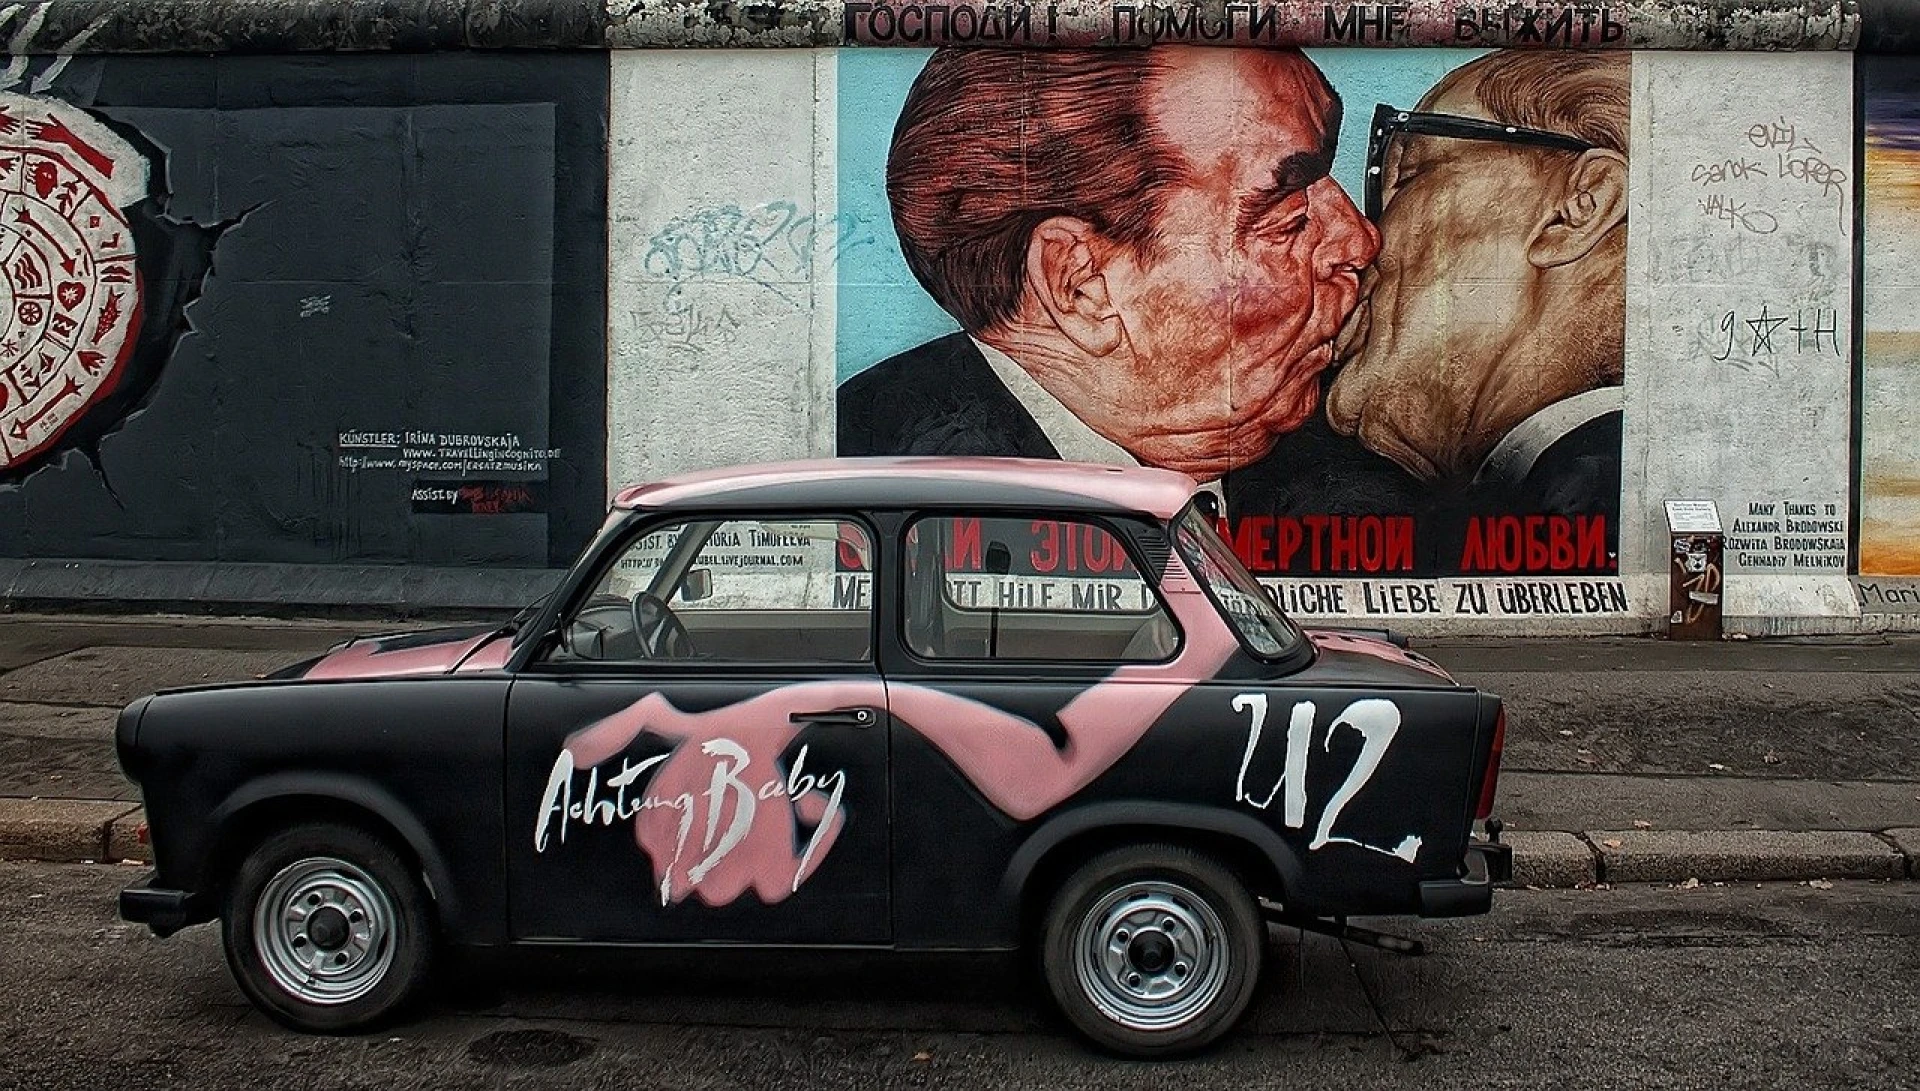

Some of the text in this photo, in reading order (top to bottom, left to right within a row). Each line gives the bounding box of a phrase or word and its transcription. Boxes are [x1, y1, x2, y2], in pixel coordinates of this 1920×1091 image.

[1451, 582, 1489, 614] ZU
[534, 737, 845, 907] Achtung Baby
[1231, 693, 1422, 863] U2
